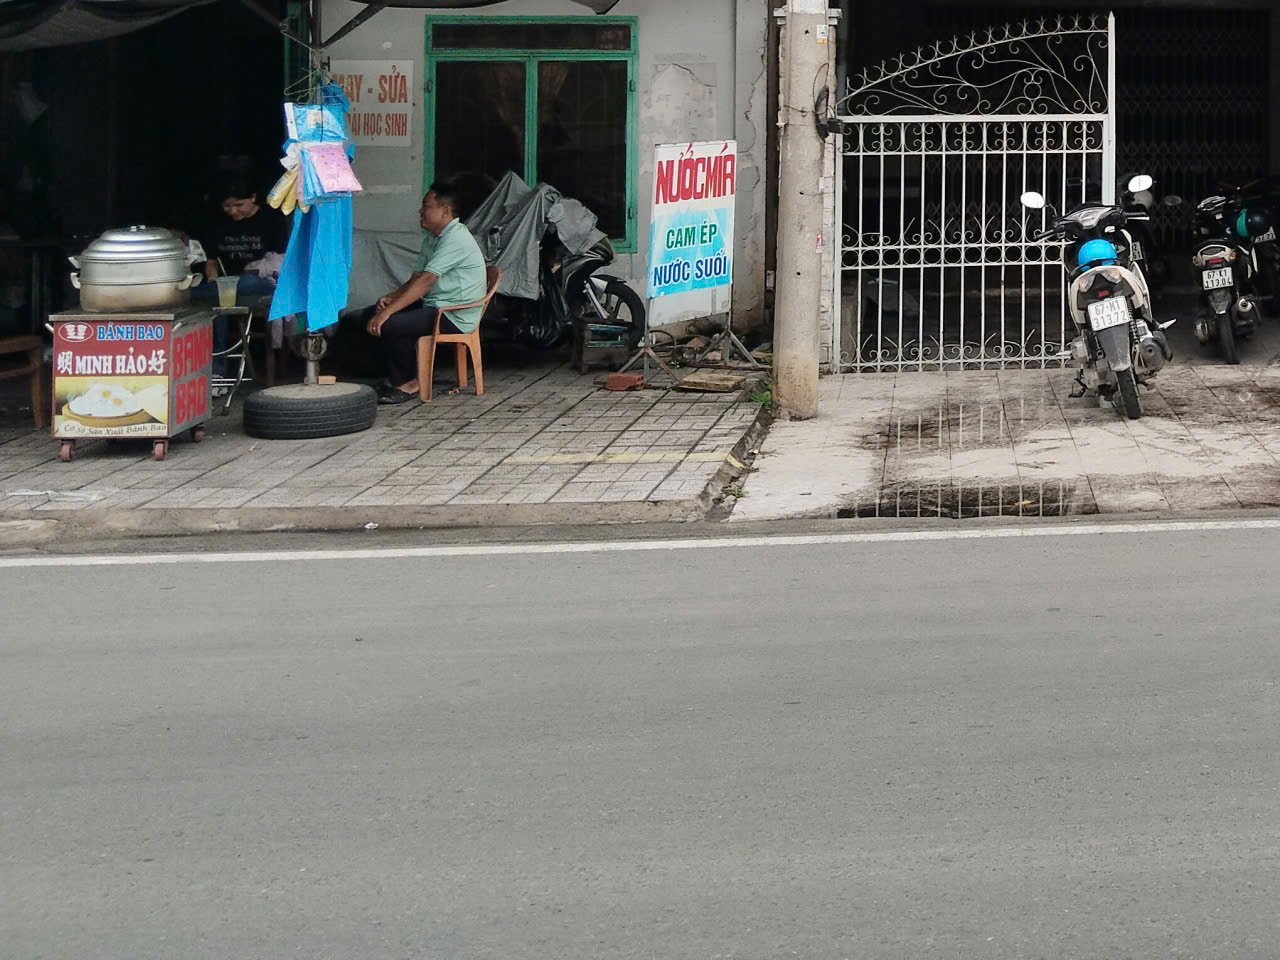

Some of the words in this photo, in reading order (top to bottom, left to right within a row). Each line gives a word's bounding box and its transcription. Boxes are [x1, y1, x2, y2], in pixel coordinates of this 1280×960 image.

[378, 64, 408, 103] SỬA
[363, 112, 383, 142] HỌC
[385, 112, 408, 137] SINH
[666, 226, 697, 249] CAM
[700, 220, 718, 245] ÉP
[653, 257, 691, 287] NƯỚC
[695, 249, 728, 280] SUỐI
[97, 322, 135, 341] BÁNH
[136, 324, 165, 341] BAO
[75, 355, 114, 375] MINH
[115, 346, 148, 375] HẢO
[175, 374, 208, 426] BAO
